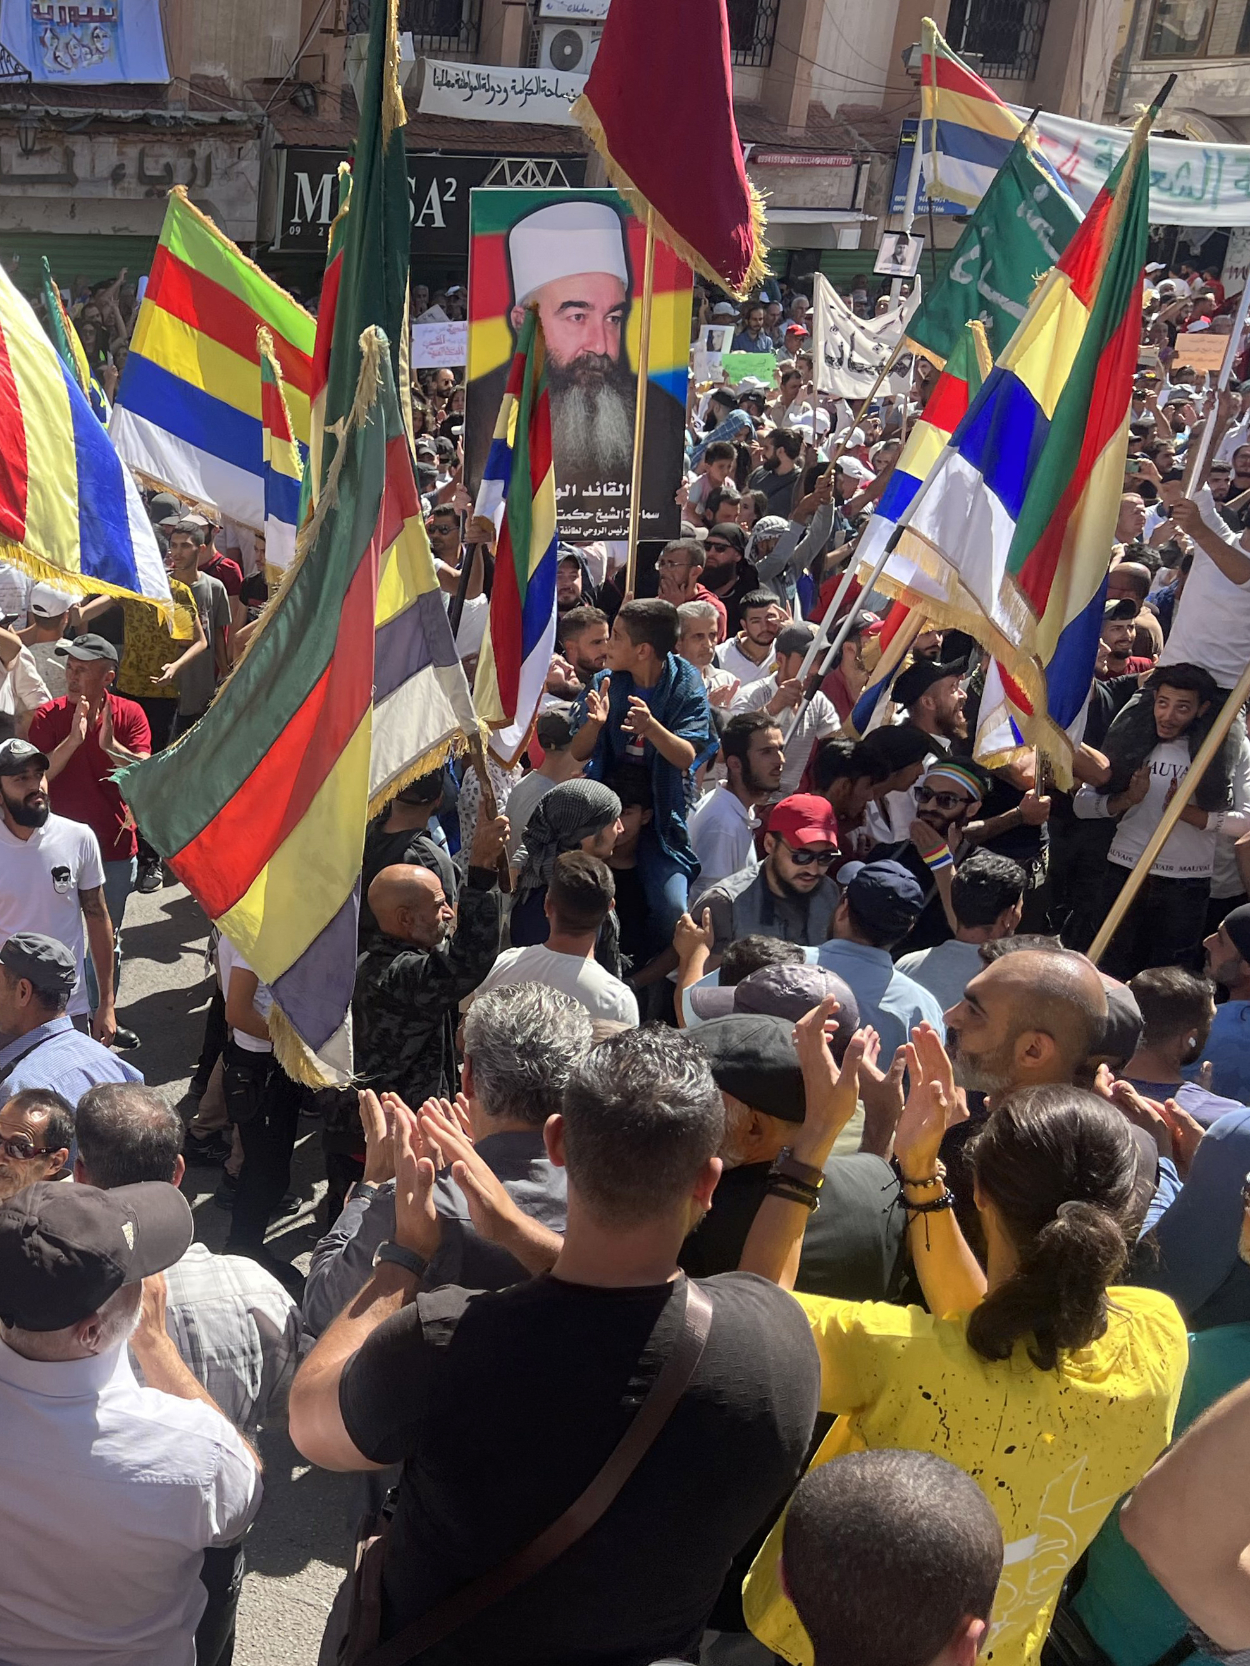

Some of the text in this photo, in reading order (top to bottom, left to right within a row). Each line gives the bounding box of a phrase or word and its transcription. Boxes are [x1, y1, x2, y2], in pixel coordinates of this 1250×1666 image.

[511, 75, 541, 108] الكرامة
[582, 481, 631, 497] القائد
[595, 506, 624, 523] الشيخ
[582, 526, 607, 537] الروحي
